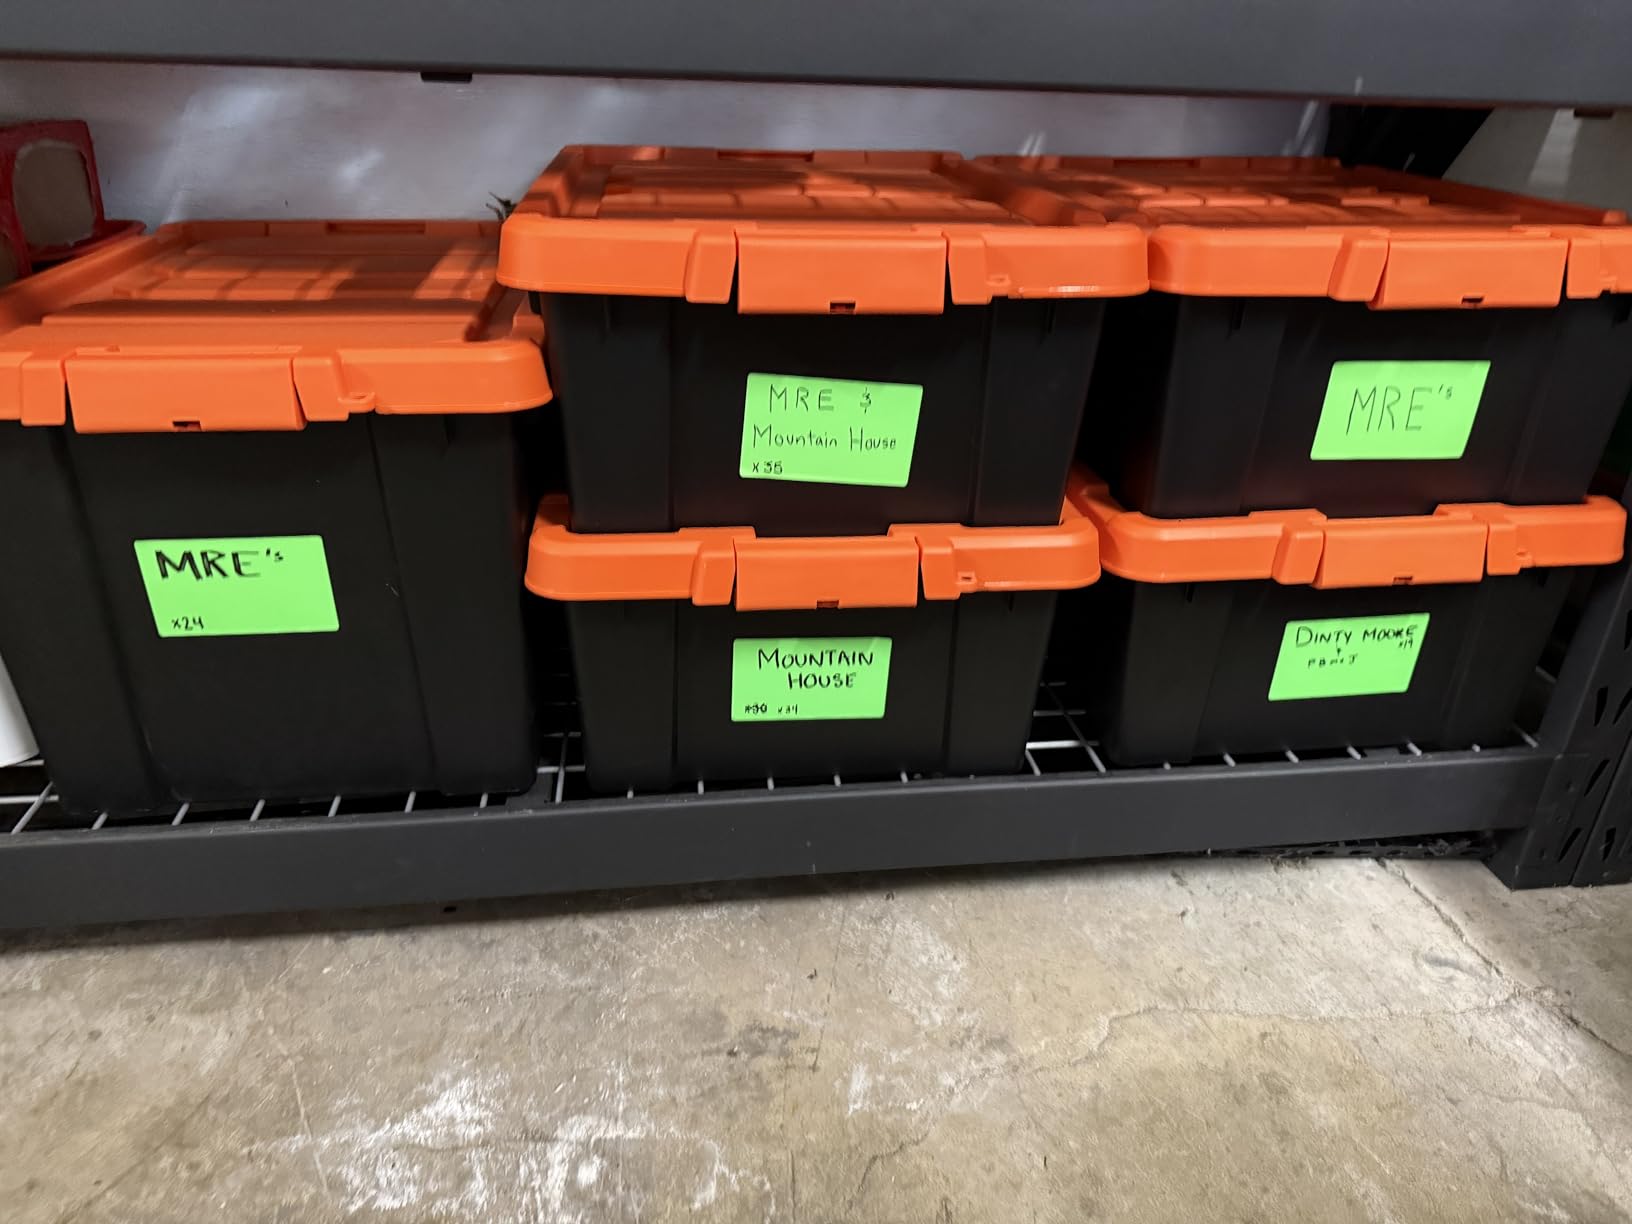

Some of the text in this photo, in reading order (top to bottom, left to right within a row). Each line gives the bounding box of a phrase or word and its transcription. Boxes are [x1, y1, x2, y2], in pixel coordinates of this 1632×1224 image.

[769, 383, 834, 413] MRE
[1345, 384, 1453, 436] MRE's
[753, 423, 897, 452] Mountain House
[155, 548, 283, 580] MRE's
[1296, 626, 1352, 647] DINTY
[758, 648, 873, 669] MOUNTAIN
[788, 671, 857, 689] HOUSE
